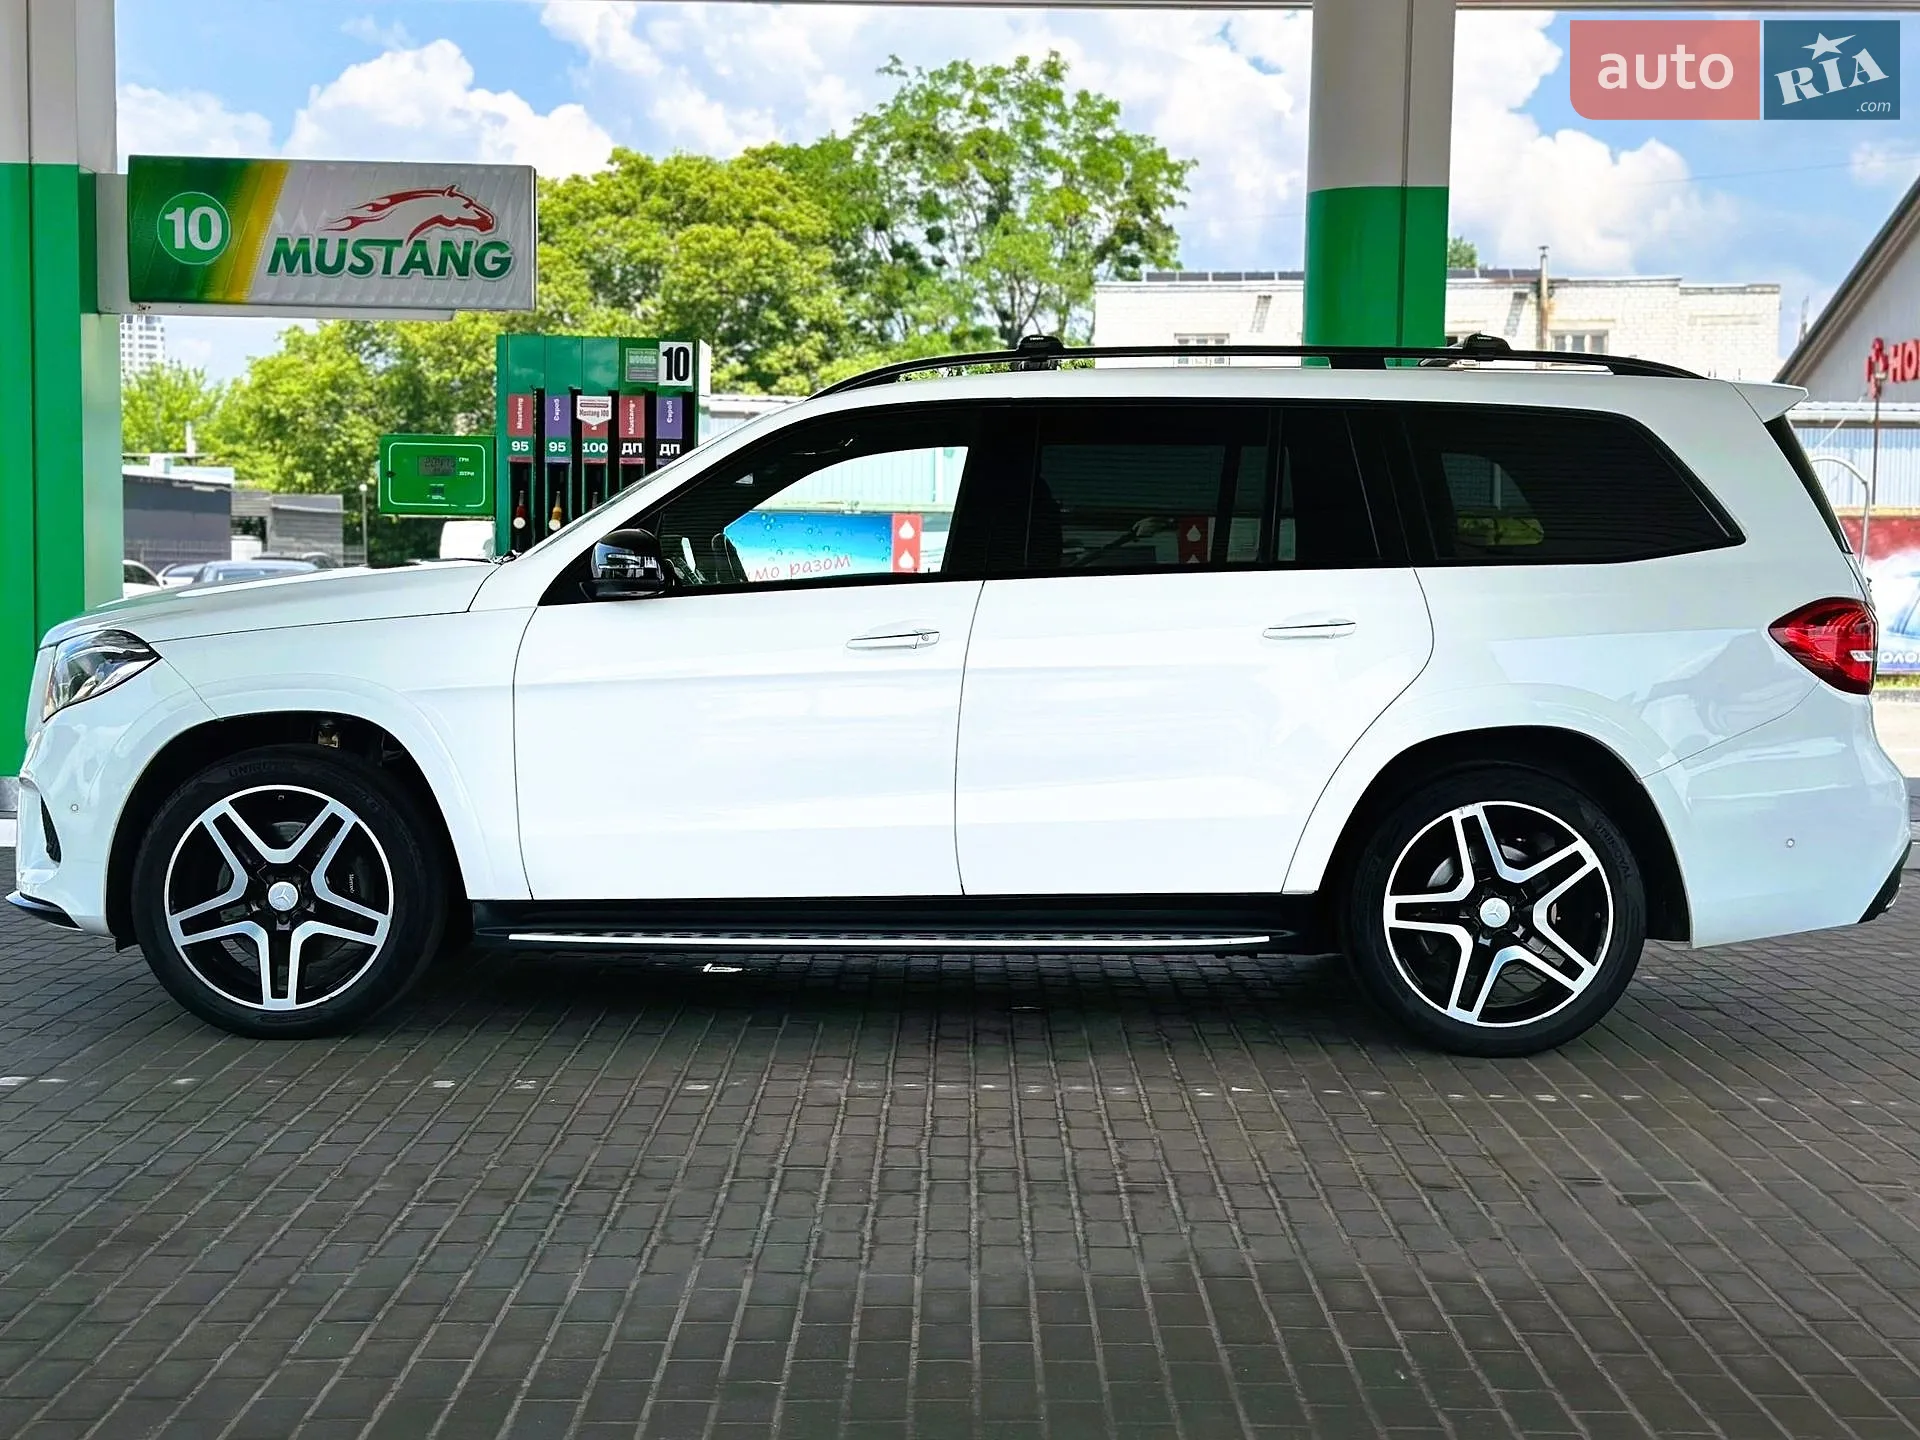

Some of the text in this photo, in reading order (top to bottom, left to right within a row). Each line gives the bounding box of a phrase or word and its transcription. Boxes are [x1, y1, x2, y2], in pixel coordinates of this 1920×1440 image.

[164, 206, 222, 251] 10
[266, 237, 514, 279] MUSTANG
[662, 346, 690, 382] 10
[1889, 340, 1920, 383] НО
[516, 397, 524, 429] Mustang
[511, 441, 529, 452] 95
[548, 441, 566, 452] 95
[582, 442, 608, 453] 100
[621, 442, 643, 455] ДП
[659, 443, 681, 455] ДП
